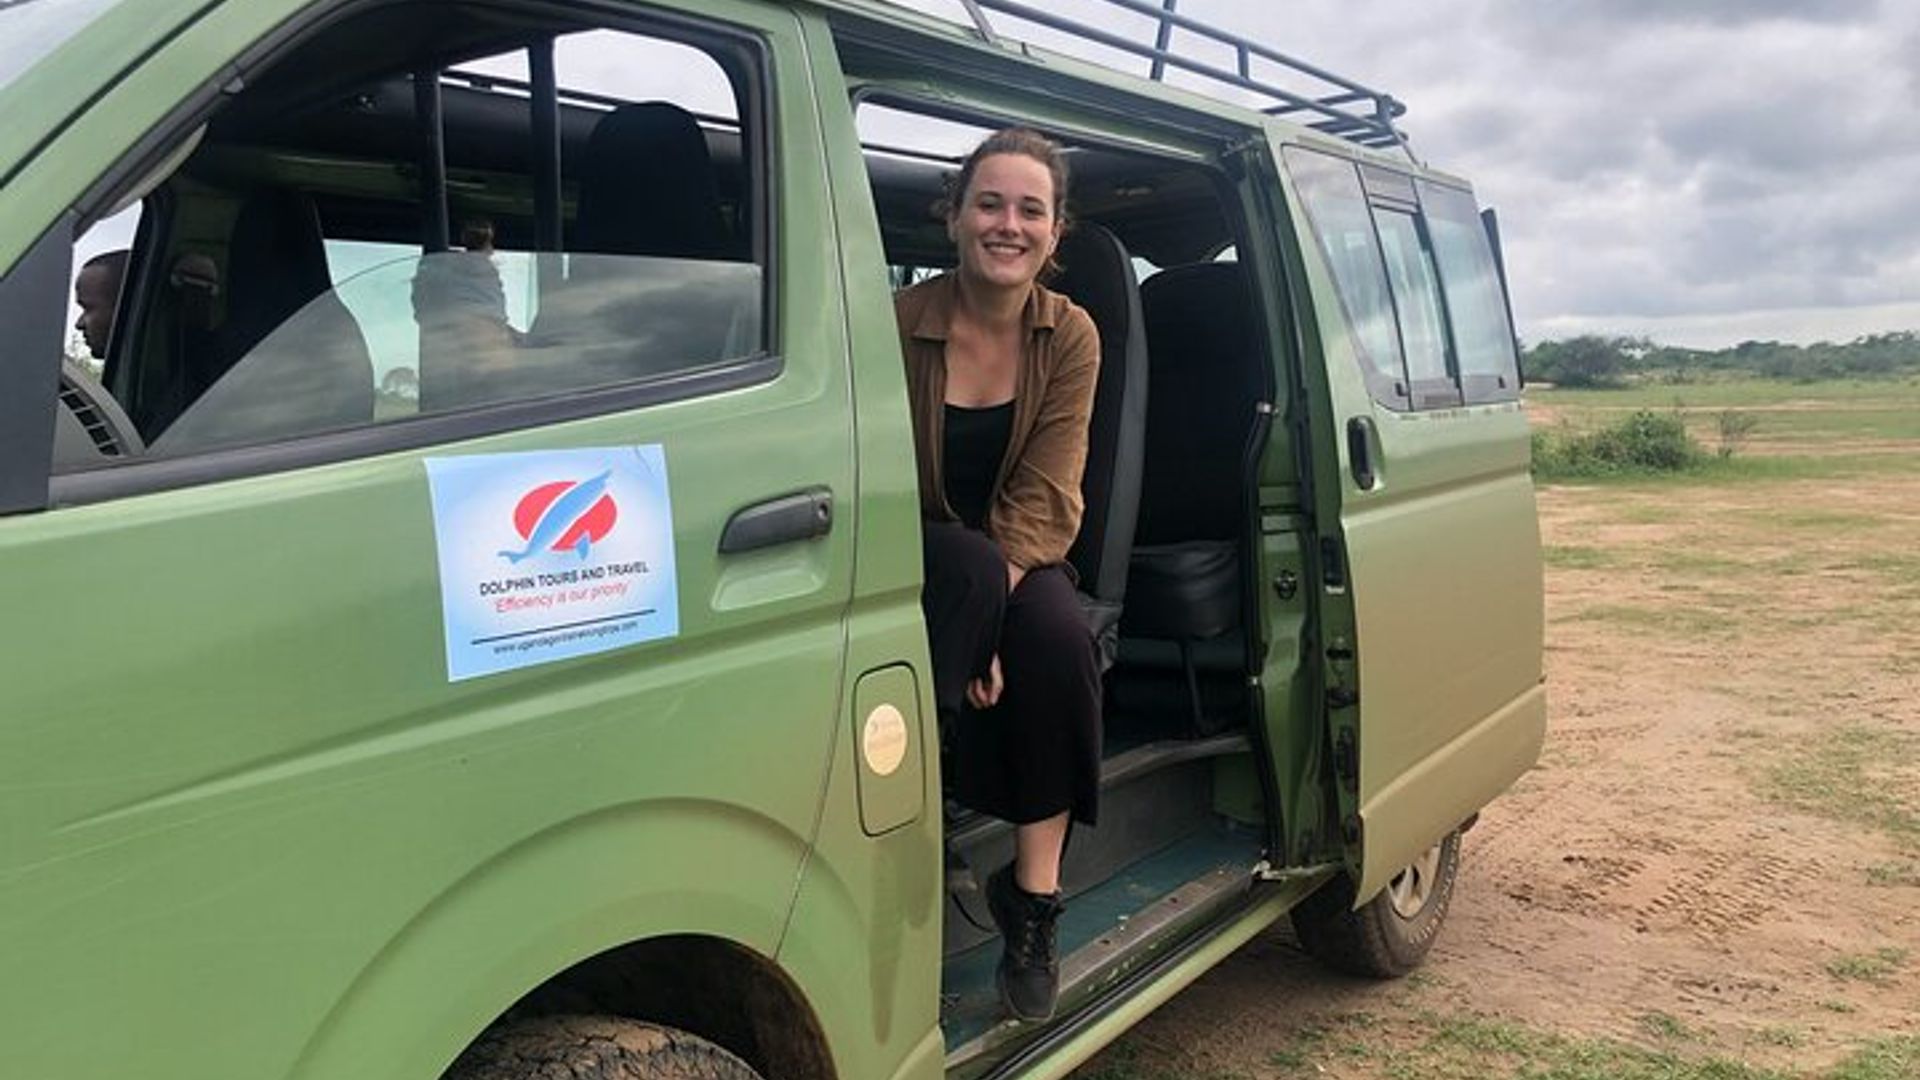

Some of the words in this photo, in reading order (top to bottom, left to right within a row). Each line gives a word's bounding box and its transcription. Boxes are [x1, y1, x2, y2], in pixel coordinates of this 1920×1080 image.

[480, 580, 535, 596] DOLPHIN
[538, 571, 578, 587] TOURS
[581, 567, 606, 581] AND
[608, 561, 649, 576] TRAVEL
